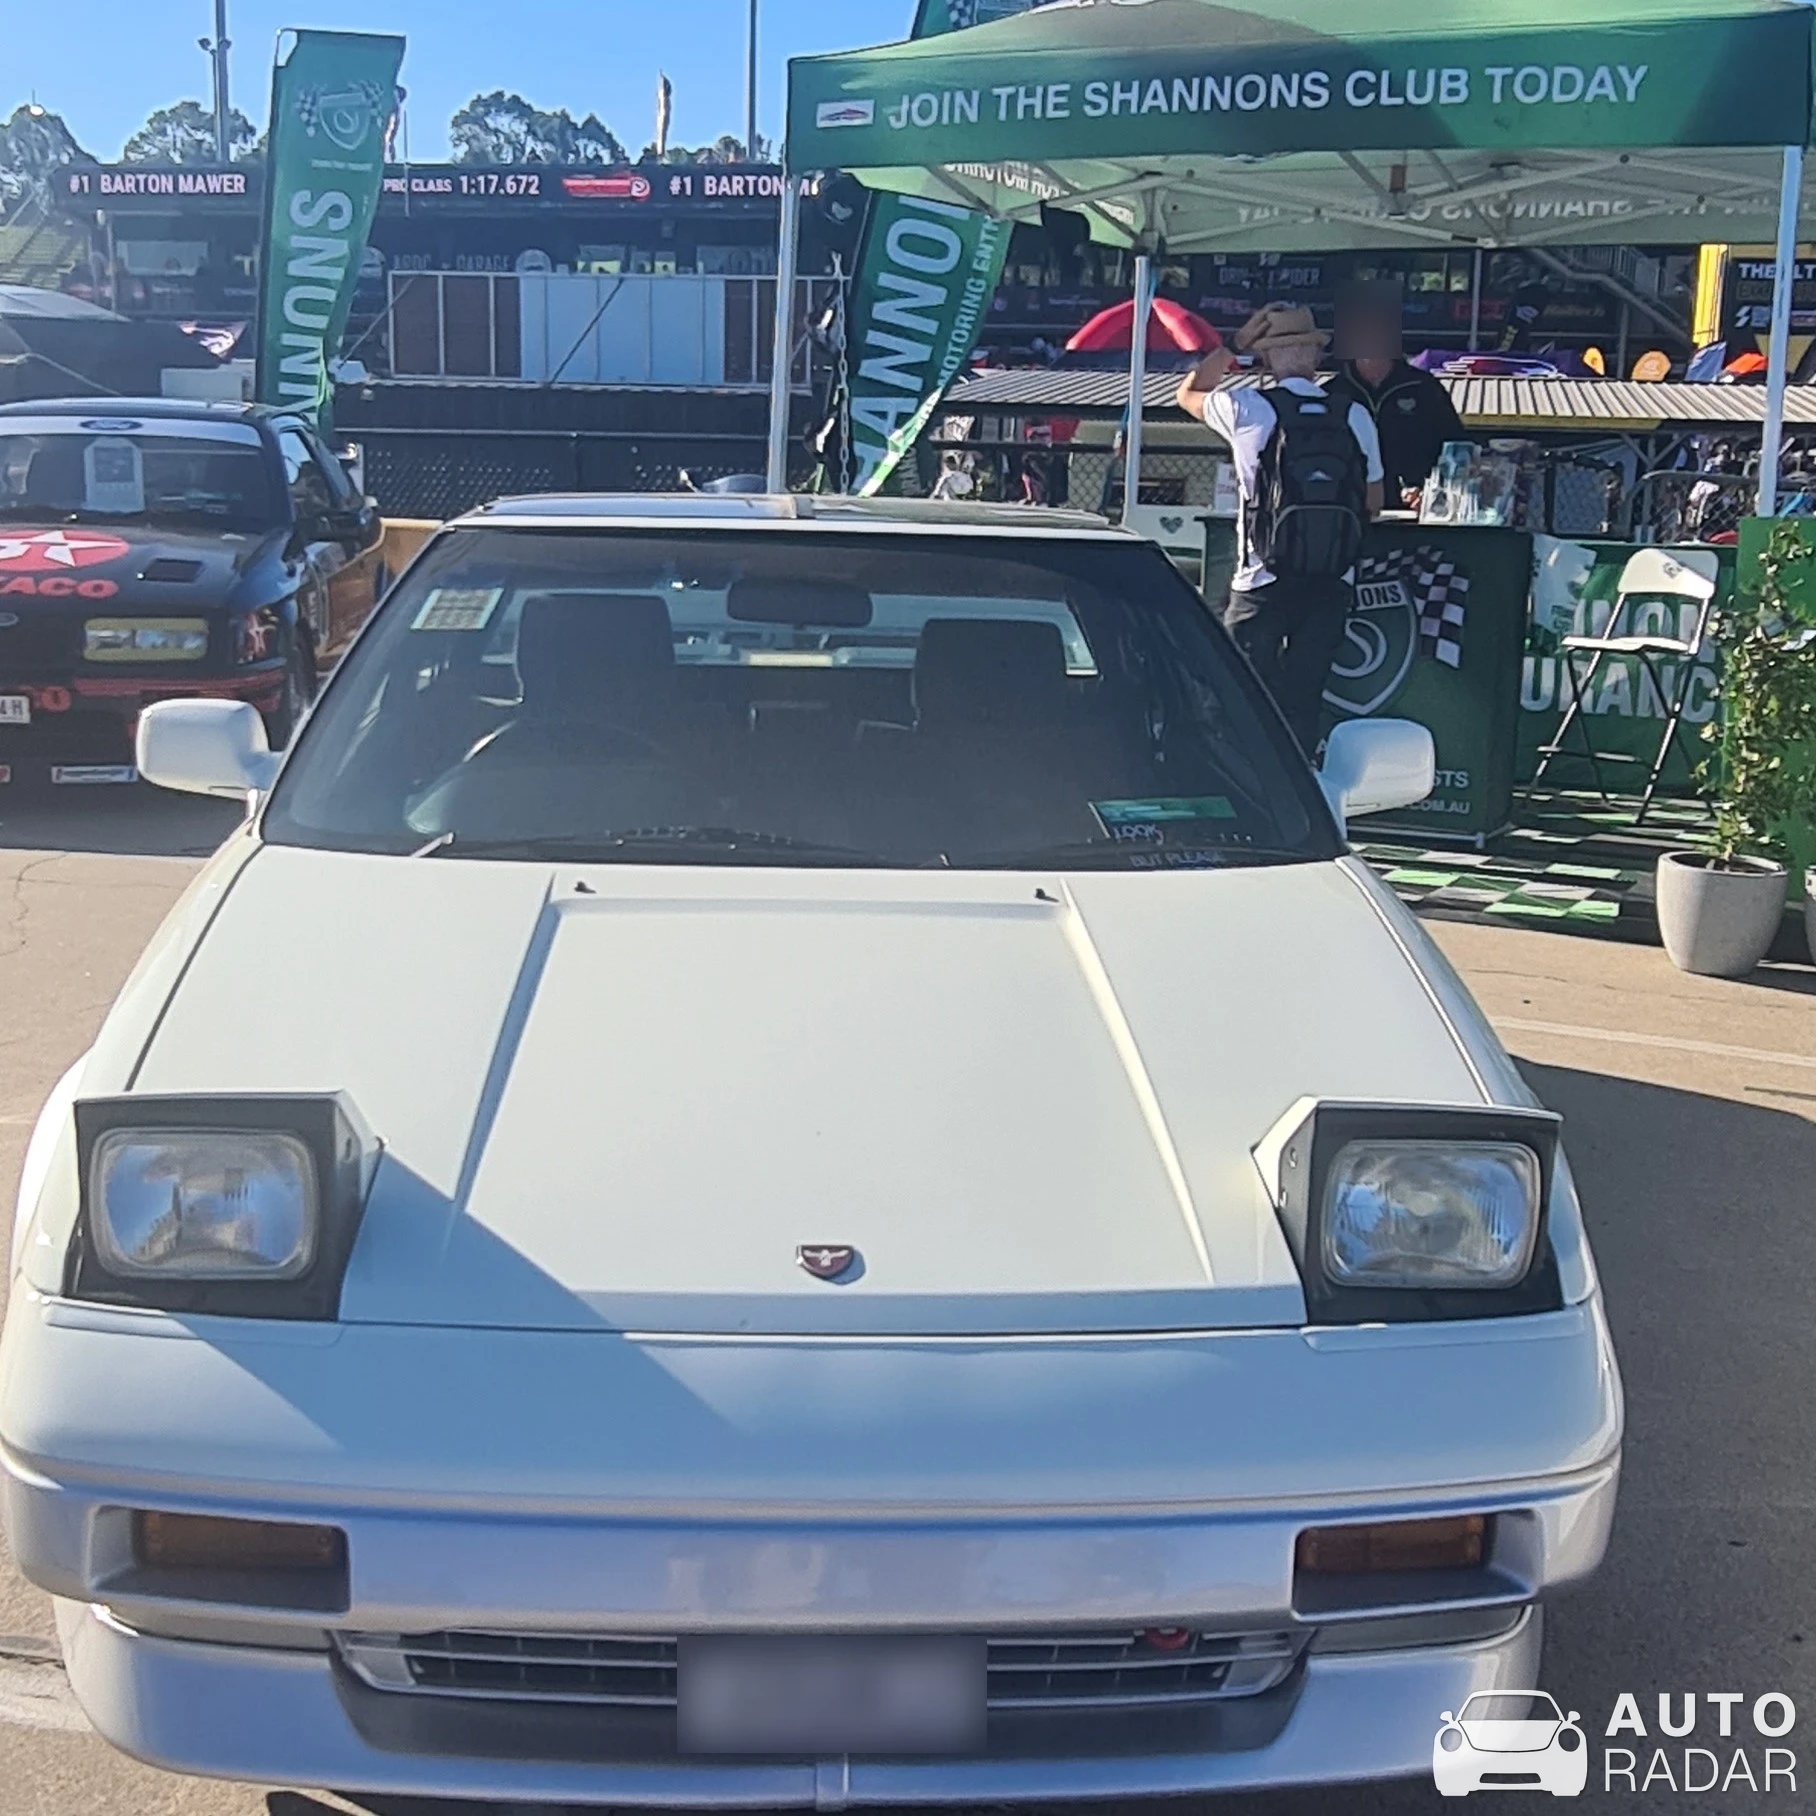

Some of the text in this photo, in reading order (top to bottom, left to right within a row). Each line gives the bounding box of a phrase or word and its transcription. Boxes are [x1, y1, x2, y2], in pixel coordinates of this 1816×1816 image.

[888, 64, 1649, 129] JOIN THE SHANNONS CLUB TODAY
[69, 174, 246, 193] #1 BARTON MAWER
[411, 178, 452, 192] CLASS
[459, 174, 540, 195] 1:17.672
[669, 175, 692, 195] #1
[704, 175, 784, 196] BARTON
[1739, 263, 1776, 279] THE
[937, 276, 987, 388] MOTORING
[0, 576, 119, 599] ACO
